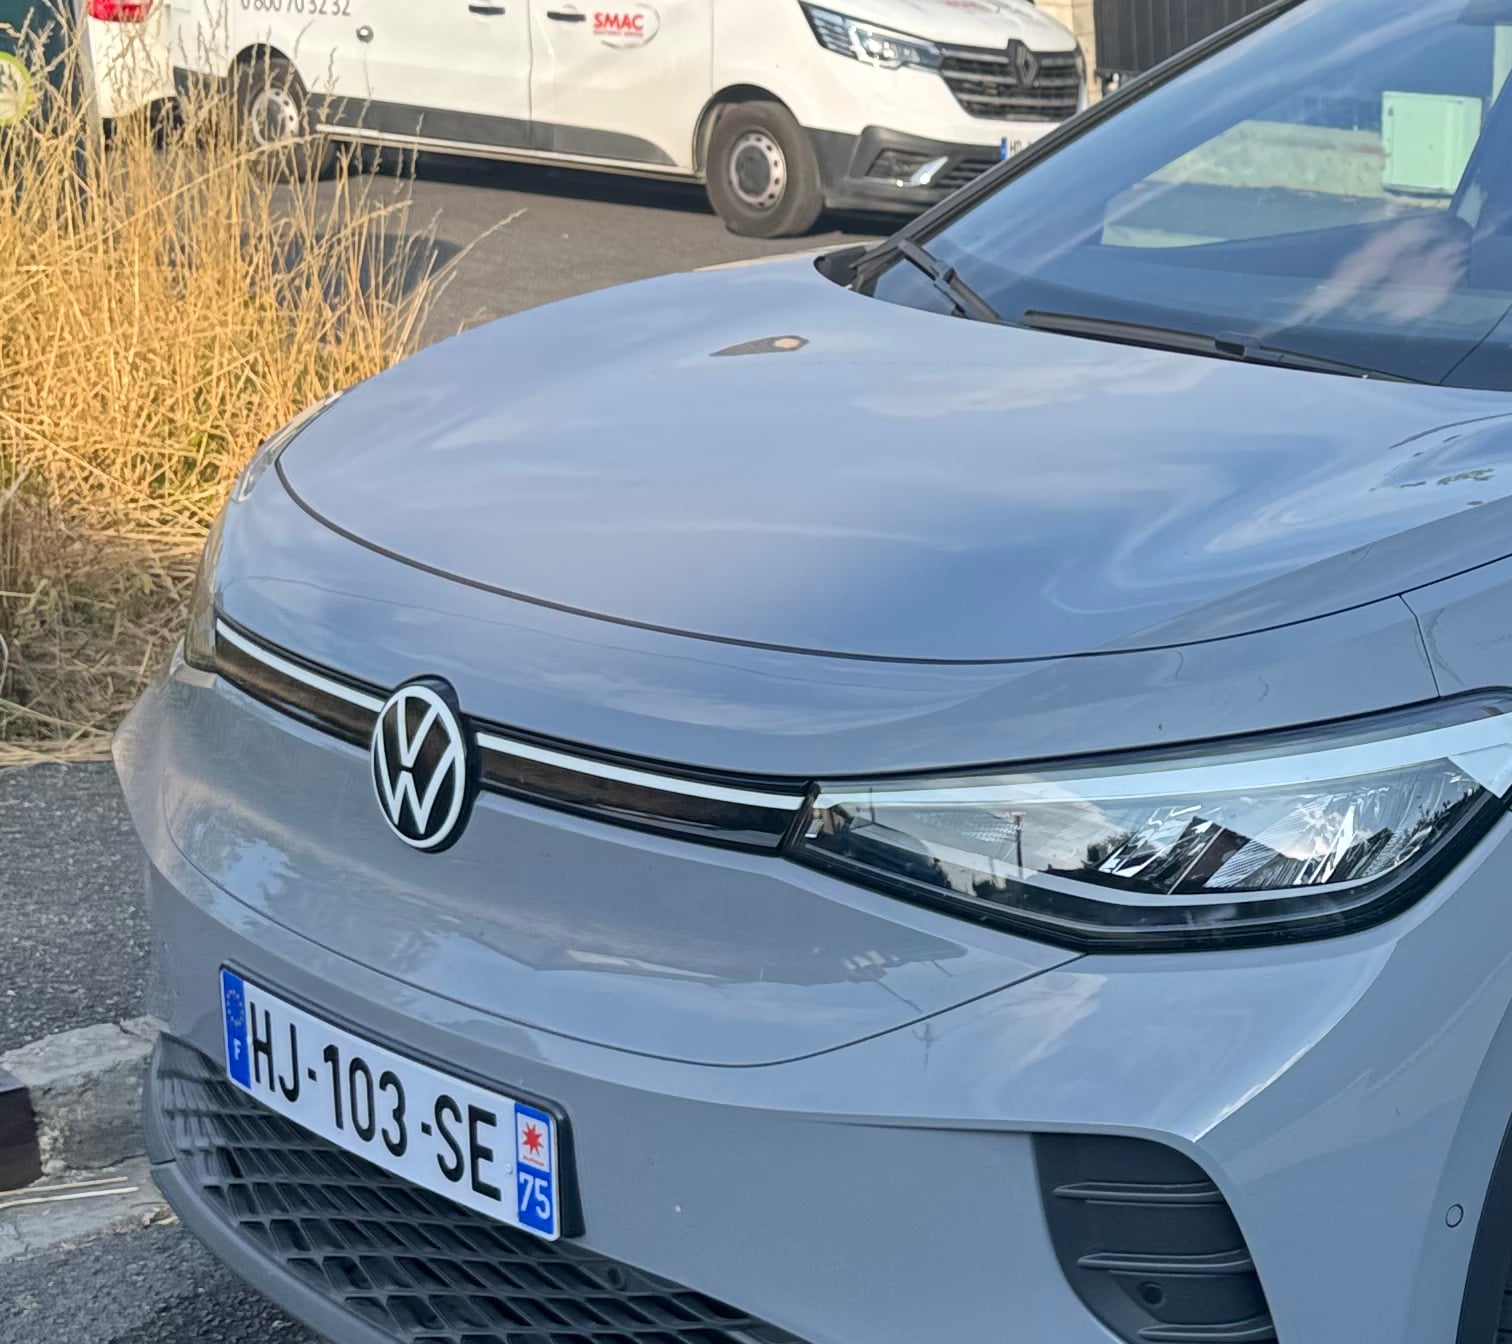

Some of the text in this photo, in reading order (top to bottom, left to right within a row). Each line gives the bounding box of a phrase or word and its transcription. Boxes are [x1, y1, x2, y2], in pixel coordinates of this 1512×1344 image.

[594, 12, 644, 31] SMAC
[373, 688, 463, 844] VW
[233, 1037, 242, 1061] F
[249, 1001, 502, 1202] HJ-103-SE
[519, 1171, 551, 1220] 75
